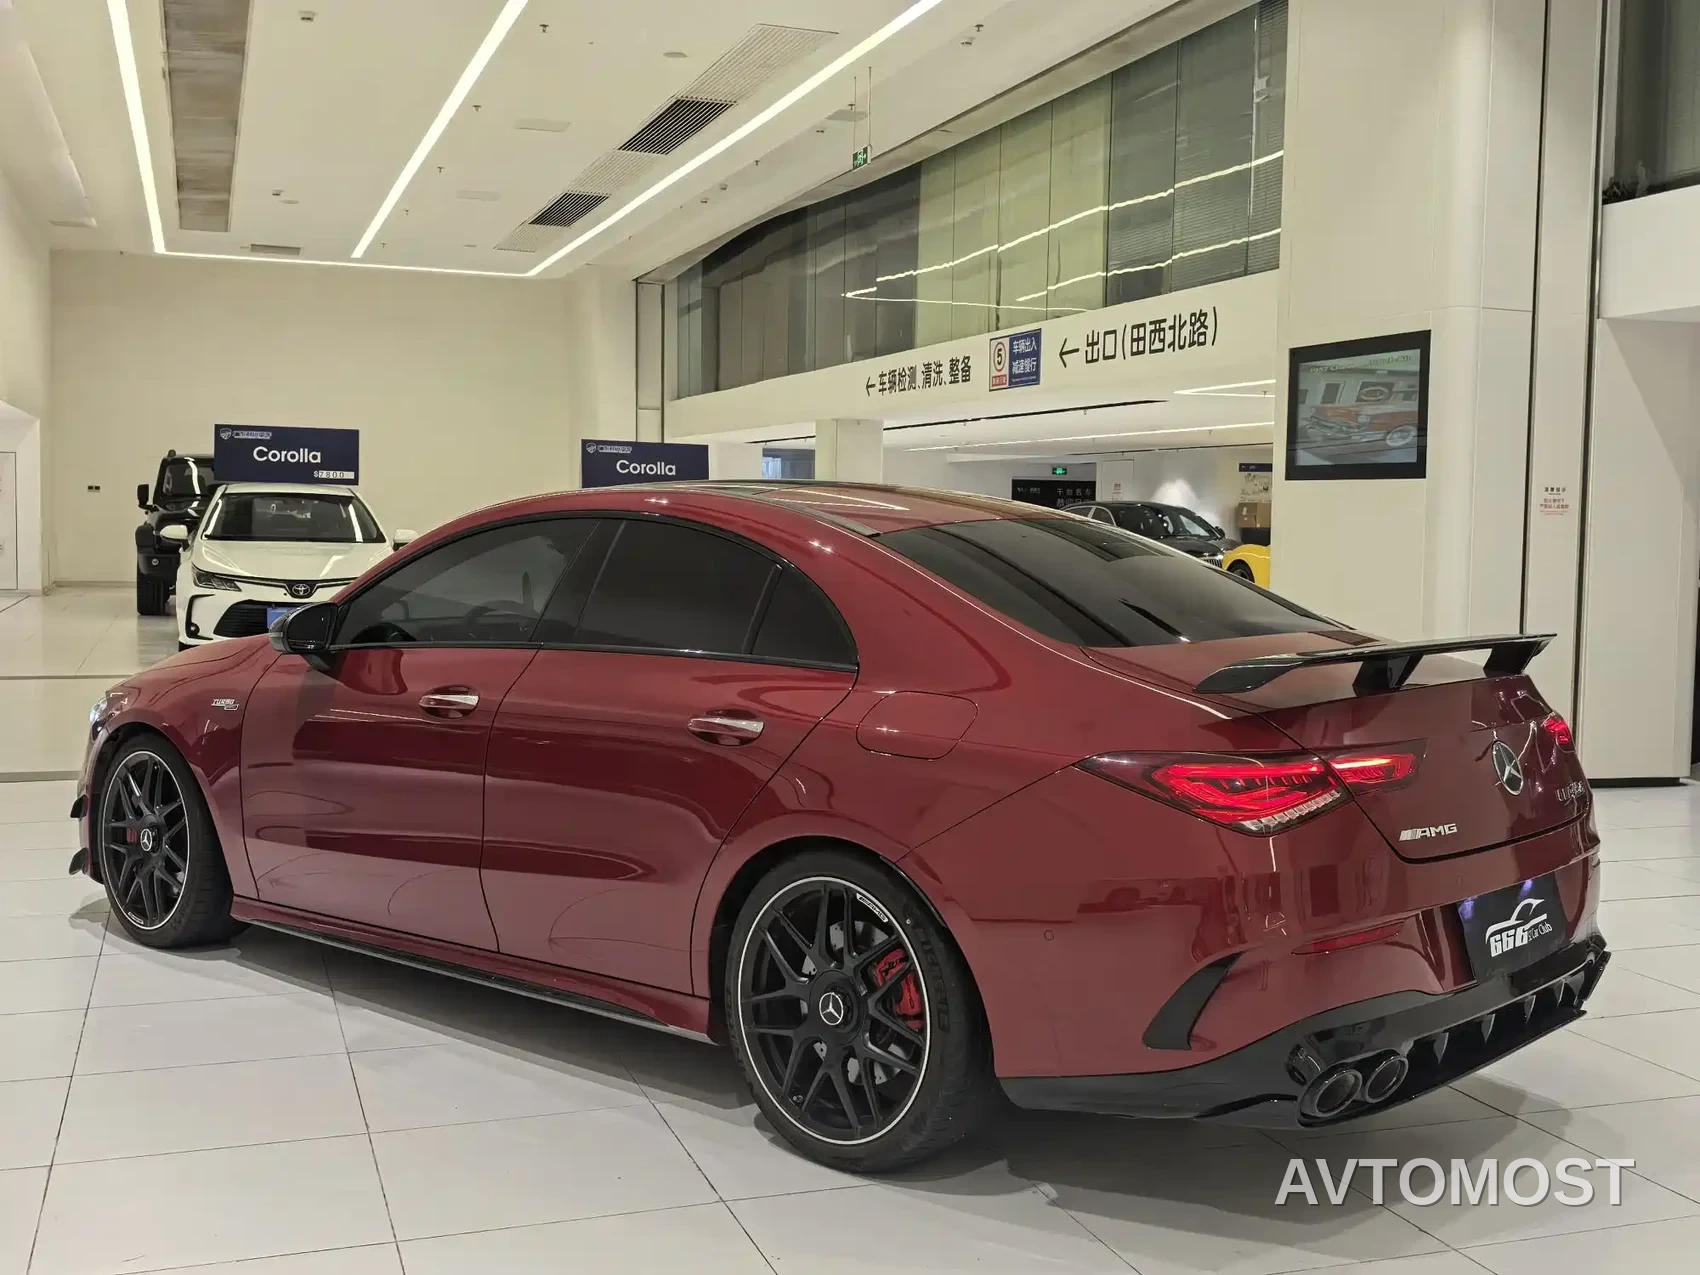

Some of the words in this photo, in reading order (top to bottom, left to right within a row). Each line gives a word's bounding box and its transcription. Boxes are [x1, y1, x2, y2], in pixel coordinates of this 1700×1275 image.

[1084, 306, 1218, 364] 出口(田西北路)
[1012, 337, 1037, 354] 车辆出入
[996, 348, 1003, 366] 5
[253, 446, 322, 463] Corolla
[616, 460, 677, 476] Corolla
[1414, 823, 1458, 839] AMG
